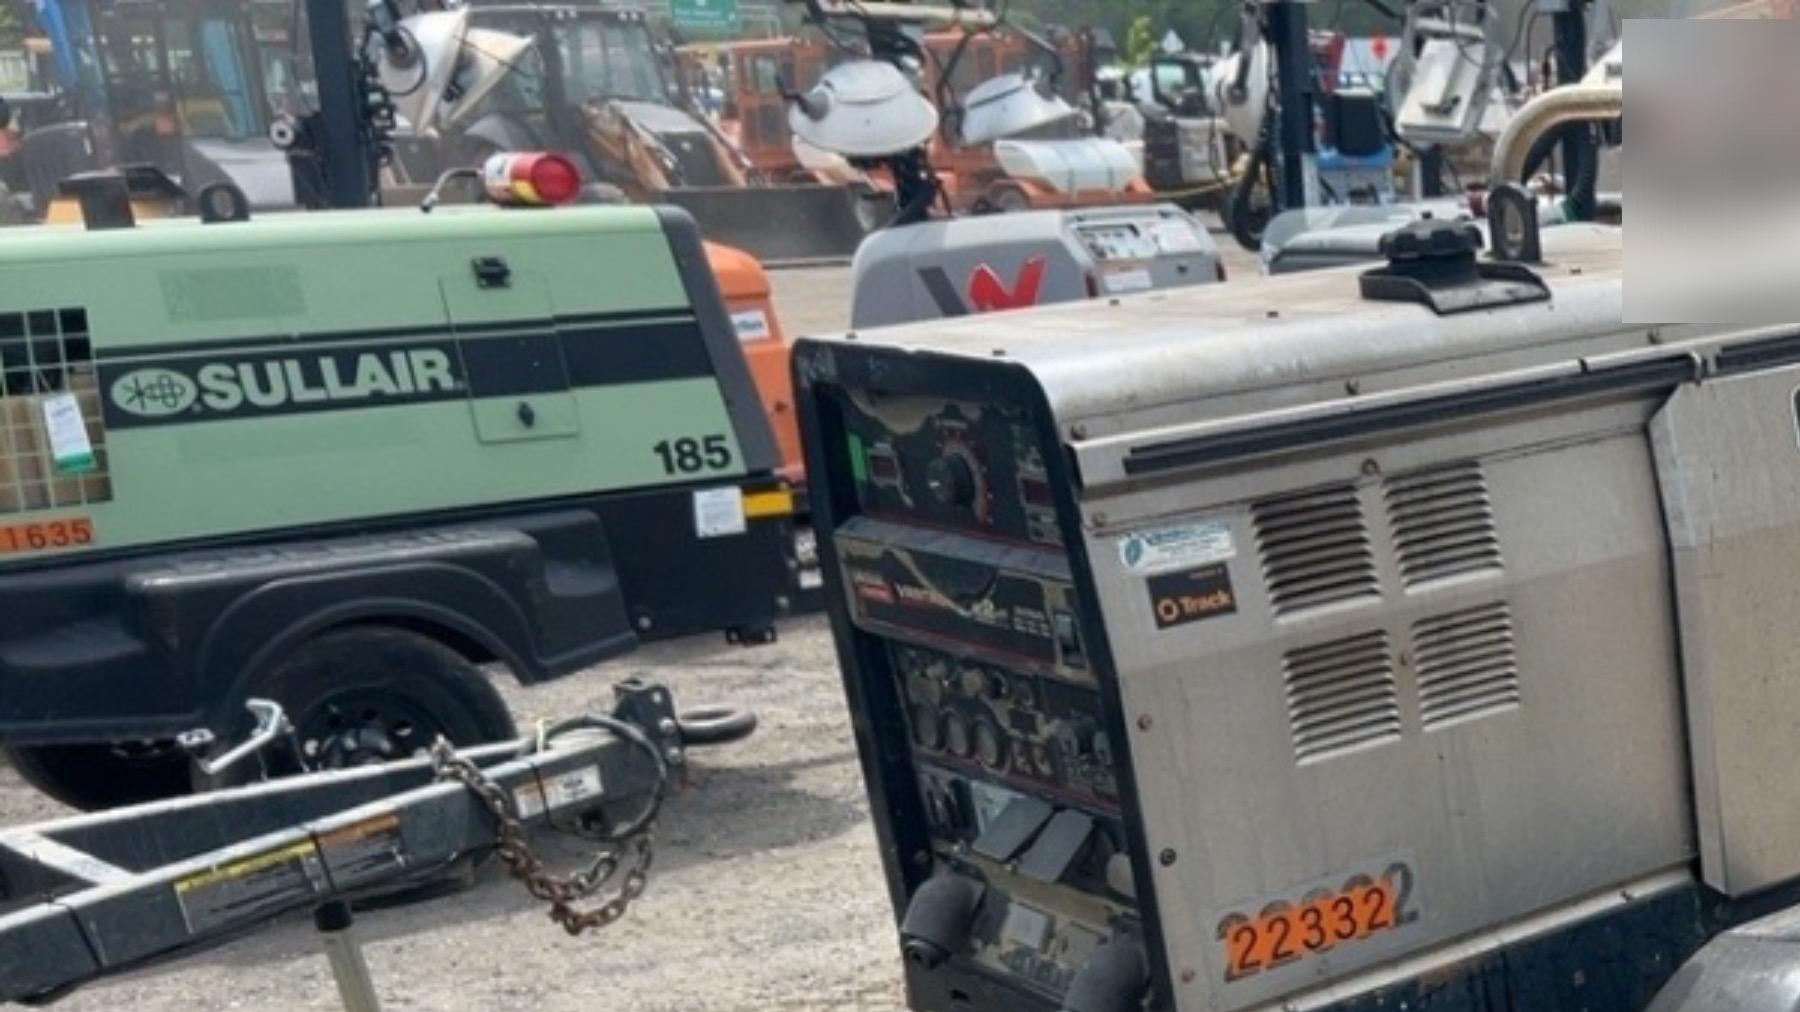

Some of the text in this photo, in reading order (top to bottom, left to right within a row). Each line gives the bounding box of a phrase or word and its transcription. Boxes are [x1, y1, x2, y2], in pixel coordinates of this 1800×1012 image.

[197, 347, 455, 412] SULLAIR
[653, 433, 732, 476] 185
[1233, 886, 1389, 970] 22332
